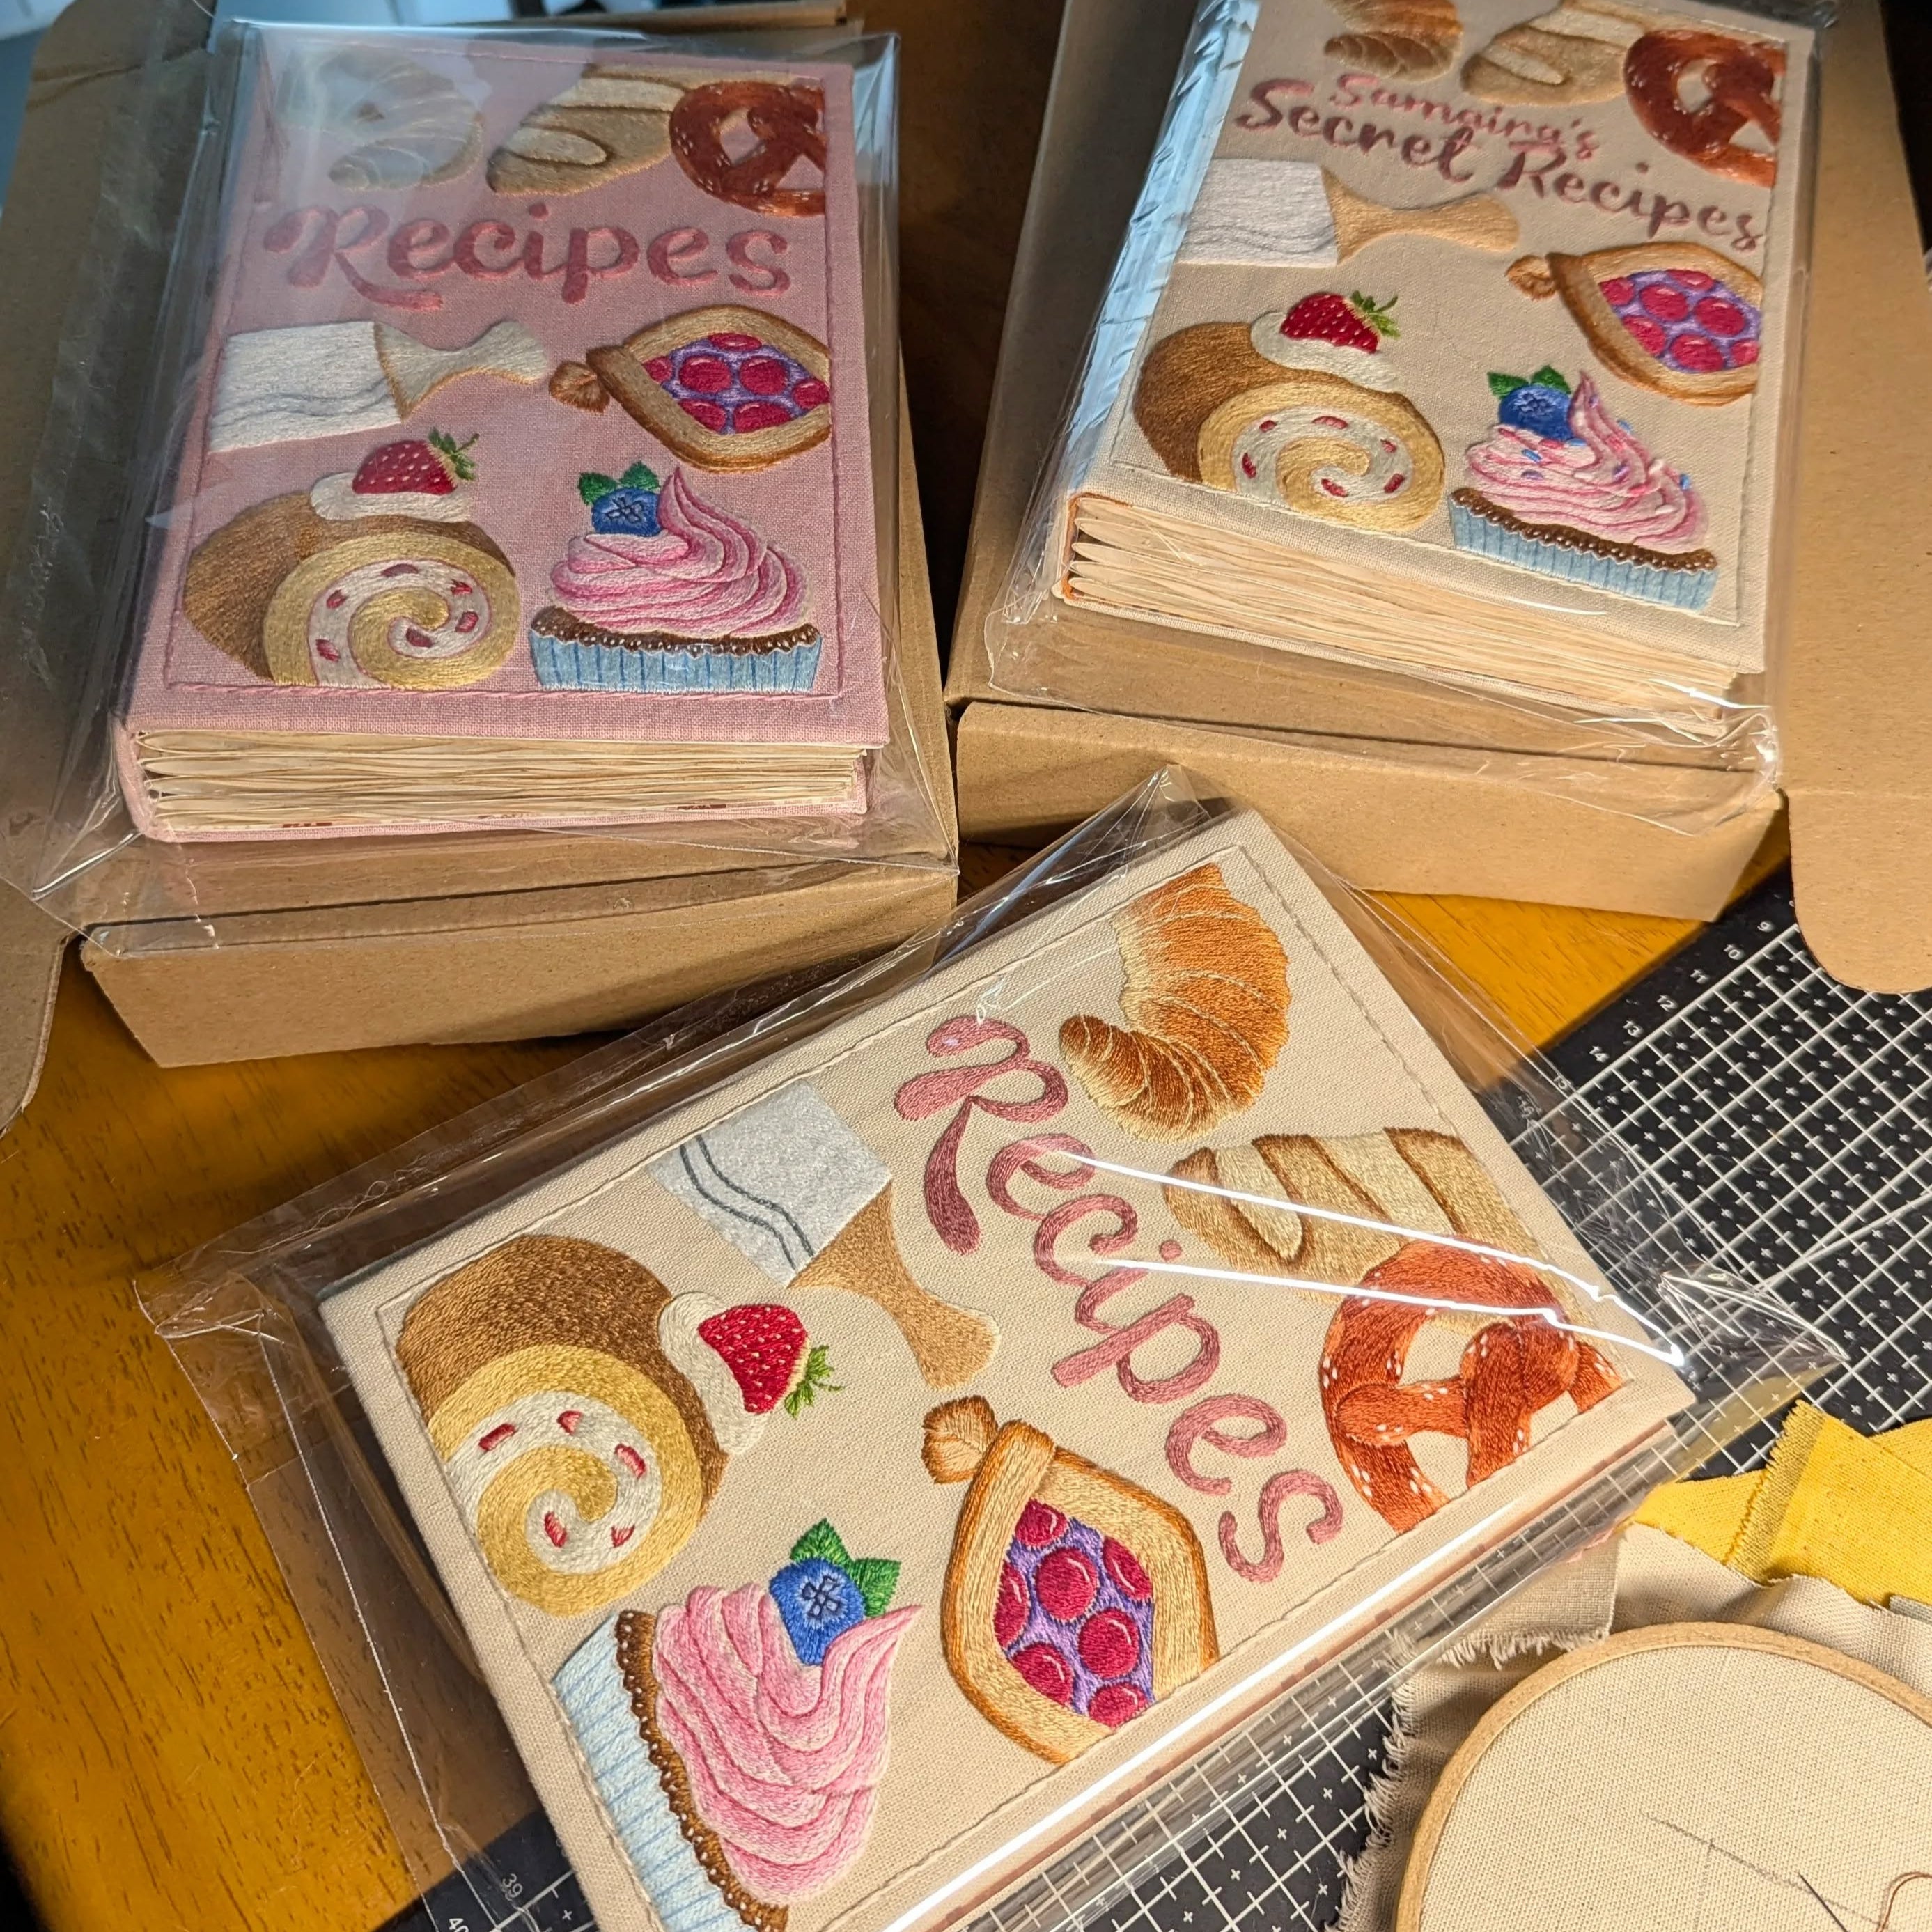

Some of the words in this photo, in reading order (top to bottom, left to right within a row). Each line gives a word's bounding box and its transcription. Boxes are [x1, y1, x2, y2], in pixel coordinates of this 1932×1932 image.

[1234, 78, 1474, 183] Secret
[1496, 141, 1763, 251] Recipes
[264, 203, 791, 311] Recipes
[1757, 921, 1771, 932] 9
[1724, 944, 1743, 960] 10
[1690, 969, 1708, 984] 11
[1657, 995, 1677, 1012] 12
[1623, 1020, 1643, 1038] 13
[1589, 1046, 1610, 1063] 14
[894, 1015, 1343, 1583] Recipes
[501, 1873, 523, 1899] 39
